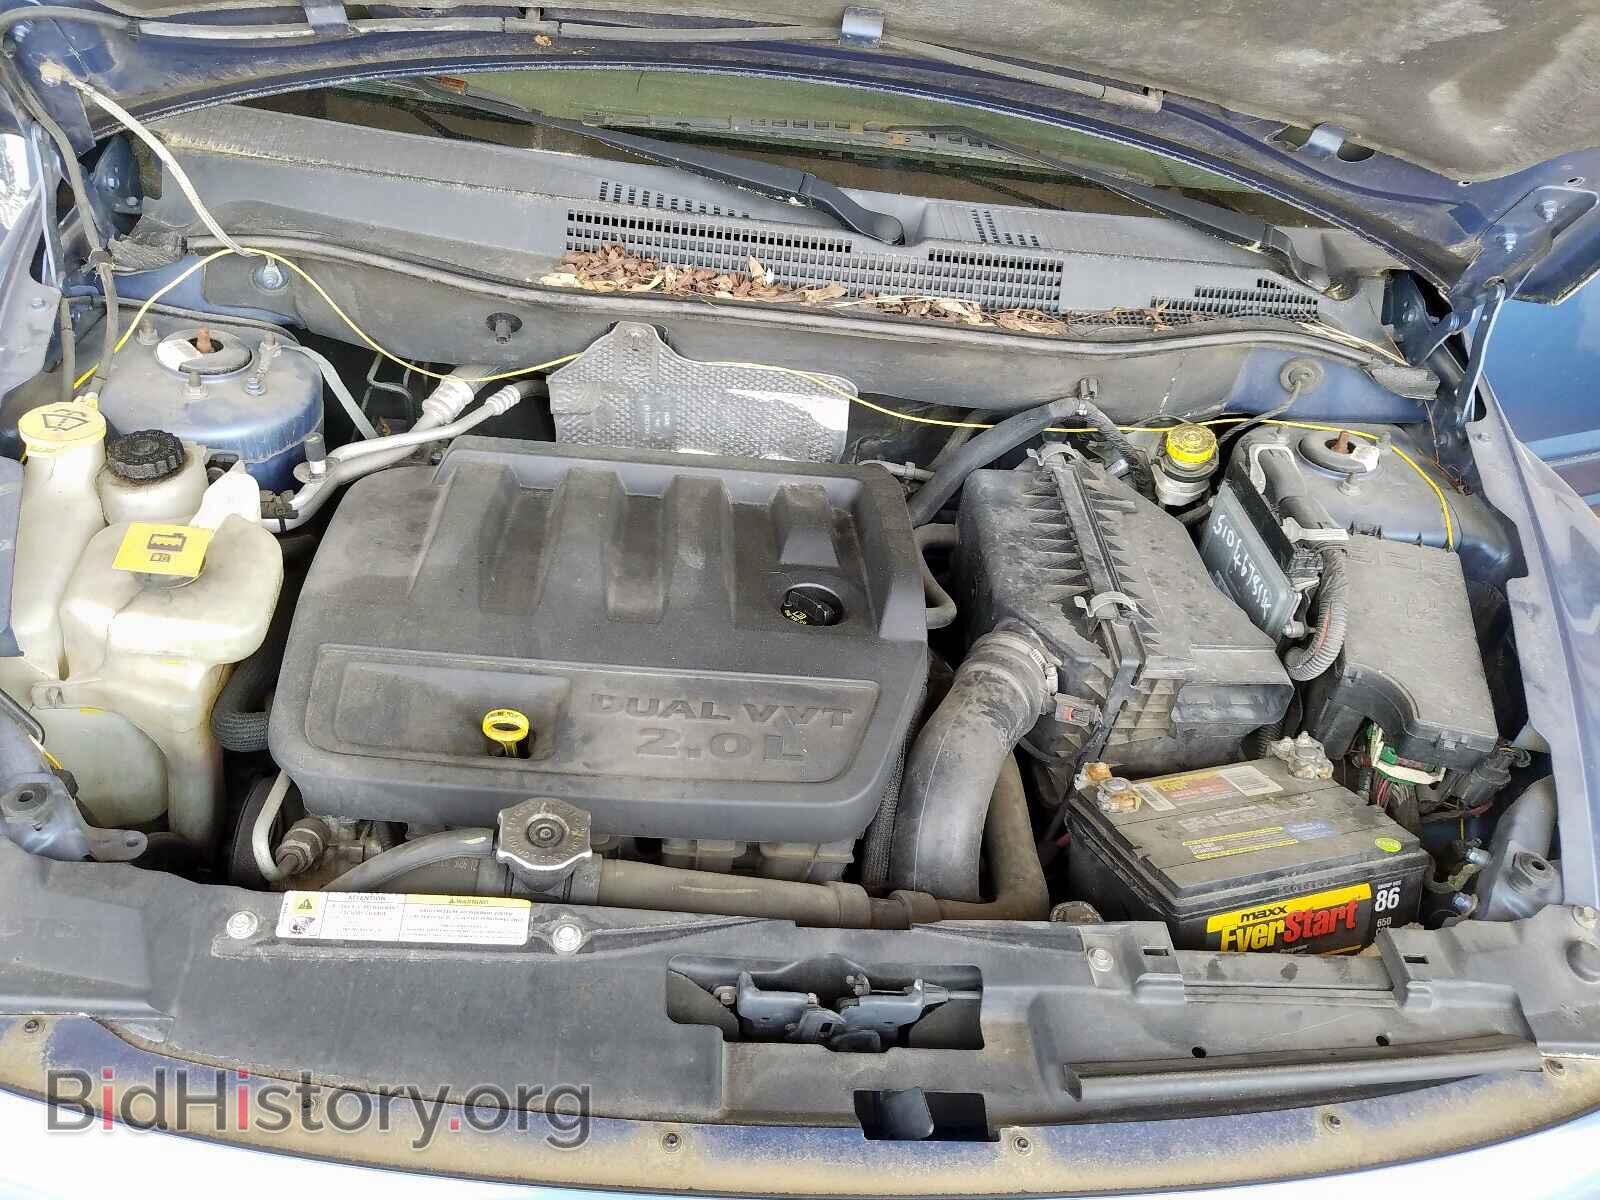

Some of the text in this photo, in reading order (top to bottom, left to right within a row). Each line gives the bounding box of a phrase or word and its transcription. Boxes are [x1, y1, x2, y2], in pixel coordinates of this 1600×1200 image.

[592, 693, 855, 728] DUAL VVT
[635, 728, 804, 761] 2.0L
[1375, 887, 1401, 912] 86
[1221, 898, 1360, 953] EverStart
